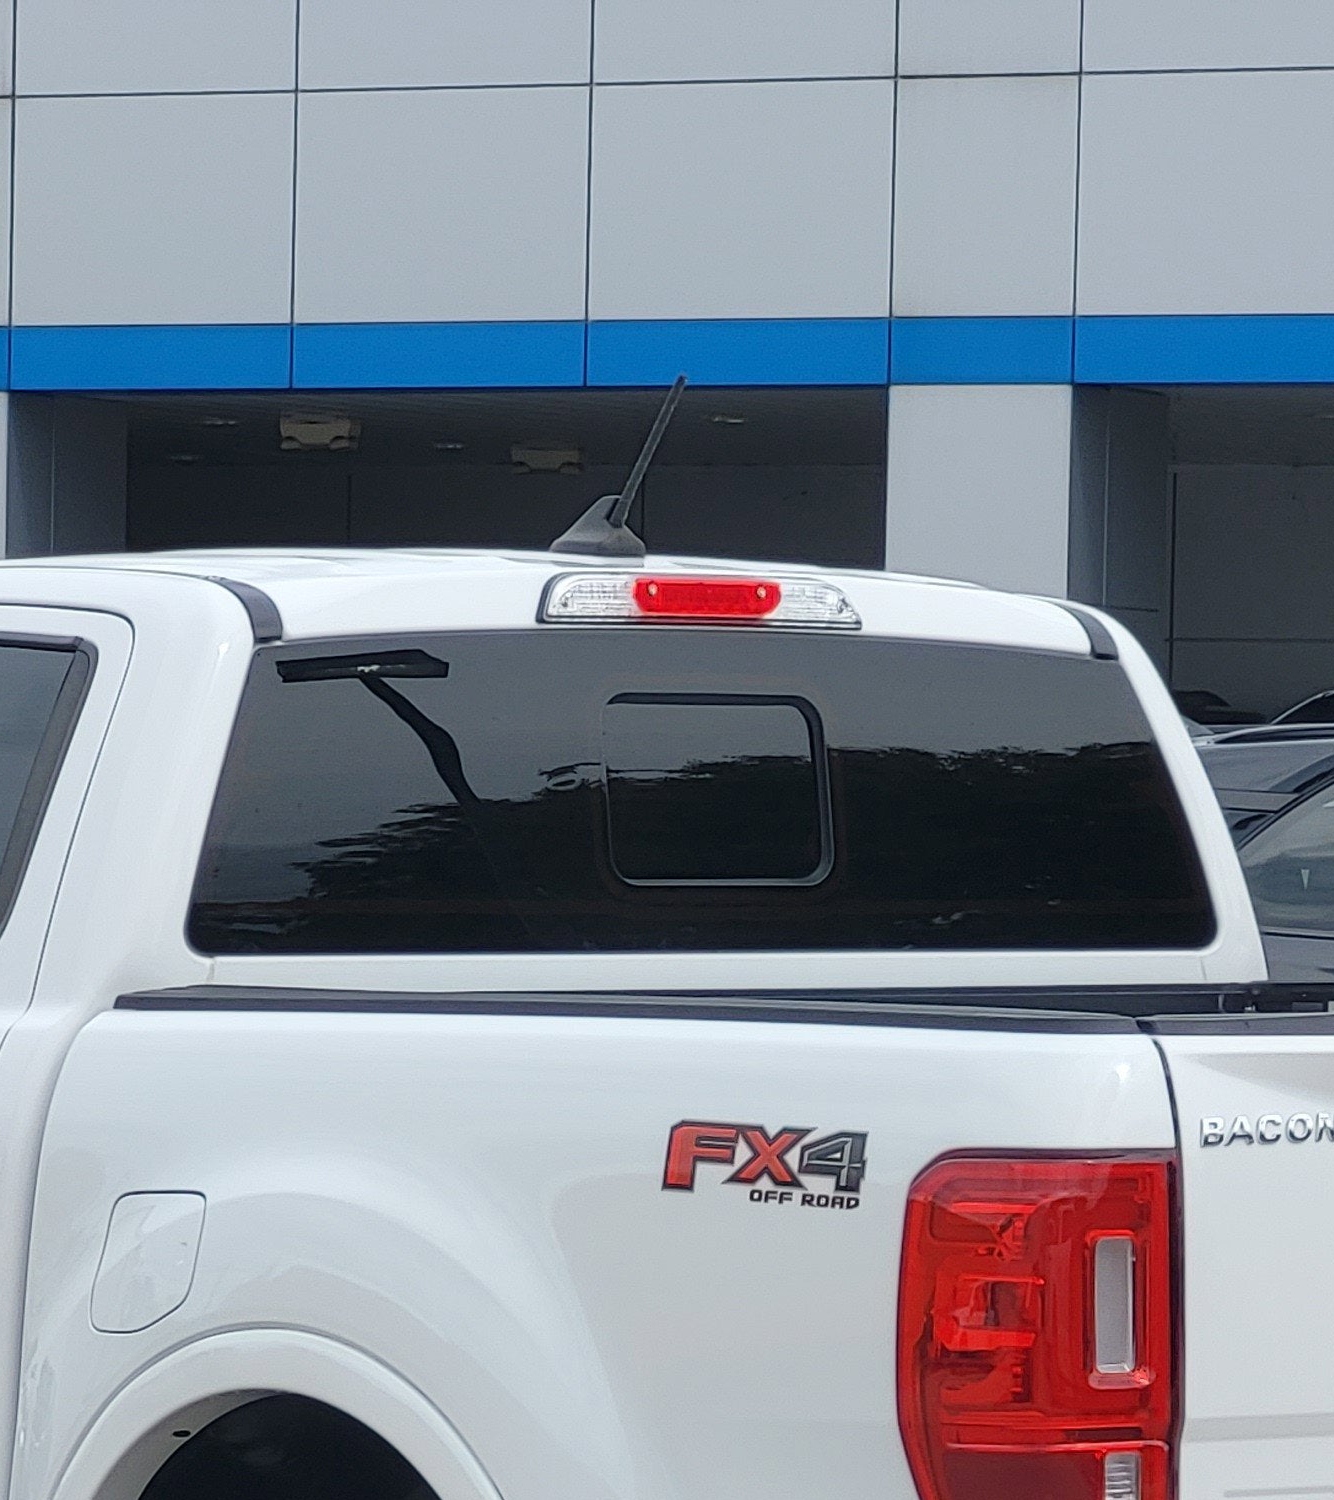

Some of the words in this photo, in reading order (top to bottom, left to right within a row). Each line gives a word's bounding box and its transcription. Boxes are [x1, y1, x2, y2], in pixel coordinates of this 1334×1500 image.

[663, 1119, 869, 1193] FX4
[749, 1189, 793, 1205] OFF
[800, 1194, 860, 1210] ROAD
